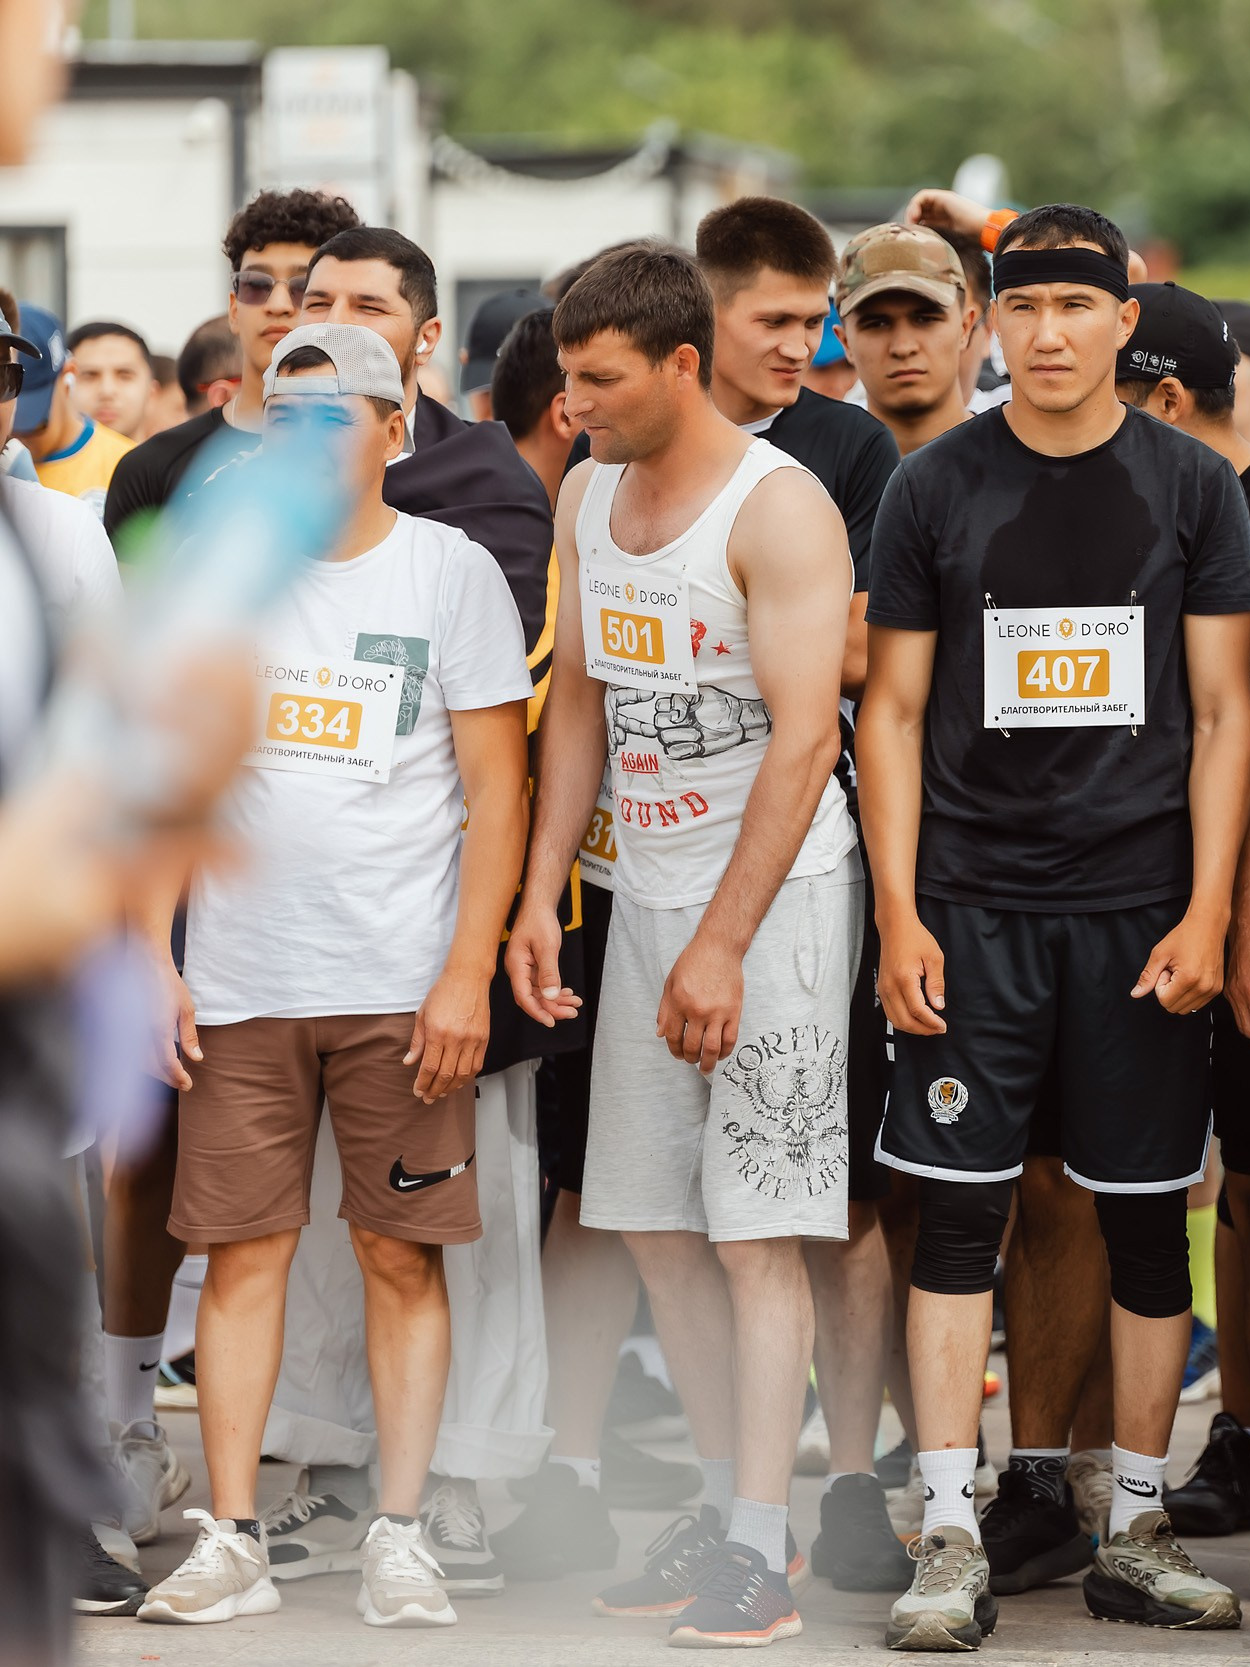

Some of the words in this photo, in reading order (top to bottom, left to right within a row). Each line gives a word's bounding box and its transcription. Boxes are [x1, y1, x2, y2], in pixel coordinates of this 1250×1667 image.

[589, 579, 620, 599] LEONE
[640, 590, 677, 607] D'ORO
[606, 615, 653, 657] 501
[998, 624, 1050, 638] LEONE
[1081, 622, 1129, 636] D'ORO
[255, 664, 309, 683] LEONE
[337, 674, 387, 692] D'ORO
[594, 658, 658, 679] БЛАГОТВОРИТЕЛЬНЫЙ
[660, 671, 682, 681] ЗАБЕГ
[1025, 655, 1101, 692] 407
[276, 700, 351, 742] 334
[1001, 703, 1100, 714] БЛАГОТВОРИТЕЛЬНЫЙ
[1102, 703, 1127, 713] ЗАБЕГ
[248, 744, 346, 763] ЛАГОТВОРИТЕЛЬНЫЙ
[346, 757, 374, 768] ЗАБЕГ
[621, 752, 659, 771] AGAIN
[614, 788, 709, 828] OUND
[721, 1024, 847, 1088] FOREVE
[1112, 1558, 1157, 1586] CORDURA
